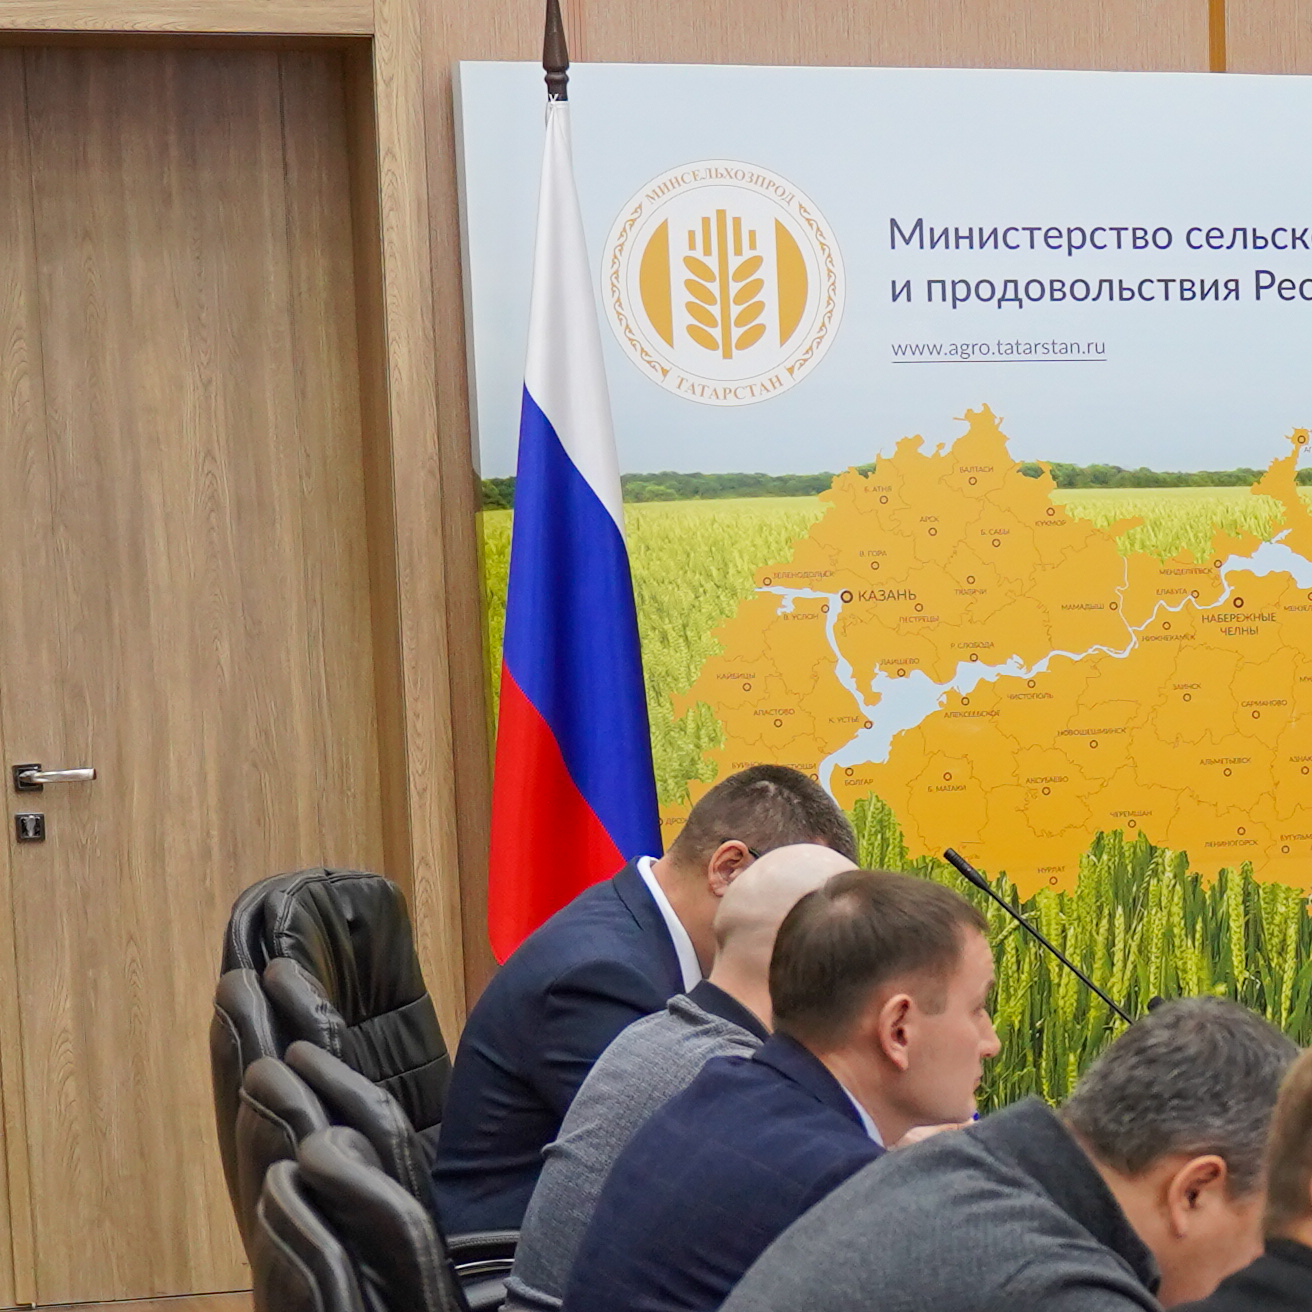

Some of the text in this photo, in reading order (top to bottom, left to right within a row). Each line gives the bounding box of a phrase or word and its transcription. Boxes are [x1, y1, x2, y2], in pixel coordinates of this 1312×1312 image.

[643, 166, 796, 206] МИНСЕЛЬХОЗПРОД
[890, 217, 1173, 255] Министерство
[891, 278, 912, 303] и
[926, 275, 1241, 310] продовольствия
[891, 339, 1106, 359] www.agro.tatarstan.ru
[674, 374, 785, 401] ТАТАРСТАН
[858, 589, 917, 603] КАЗАНЬ
[1201, 613, 1277, 623] НАБЕРЕЖНЫЕ
[1220, 626, 1259, 636] ЧЕЛНЫ
